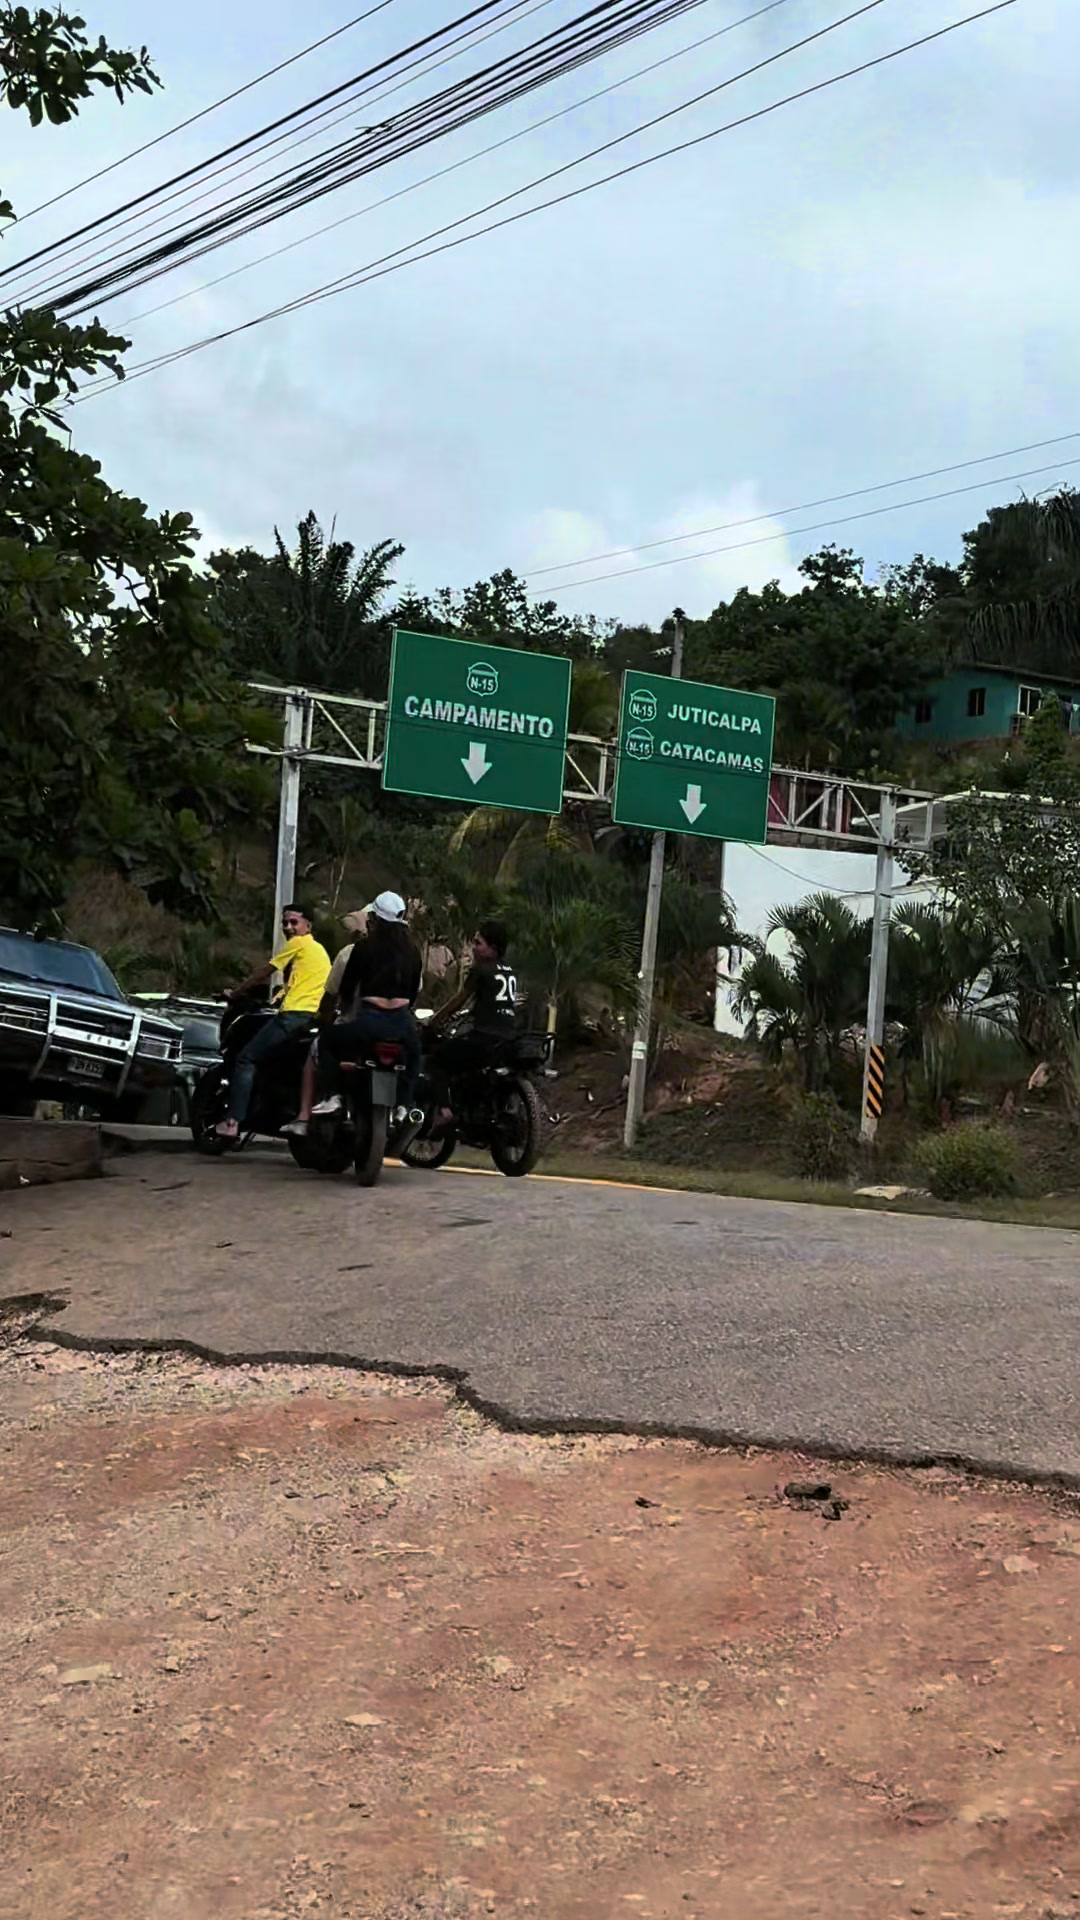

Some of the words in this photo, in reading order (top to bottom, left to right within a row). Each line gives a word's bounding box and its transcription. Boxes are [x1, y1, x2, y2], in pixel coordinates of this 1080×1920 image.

[470, 676, 494, 692] N-15
[404, 695, 554, 738] CAMPAMENTO
[632, 703, 654, 717] N-15
[667, 704, 762, 735] JUTICALPA
[629, 741, 651, 755] N-15
[660, 741, 764, 773] CATACAMAS
[494, 974, 517, 1001] 20
